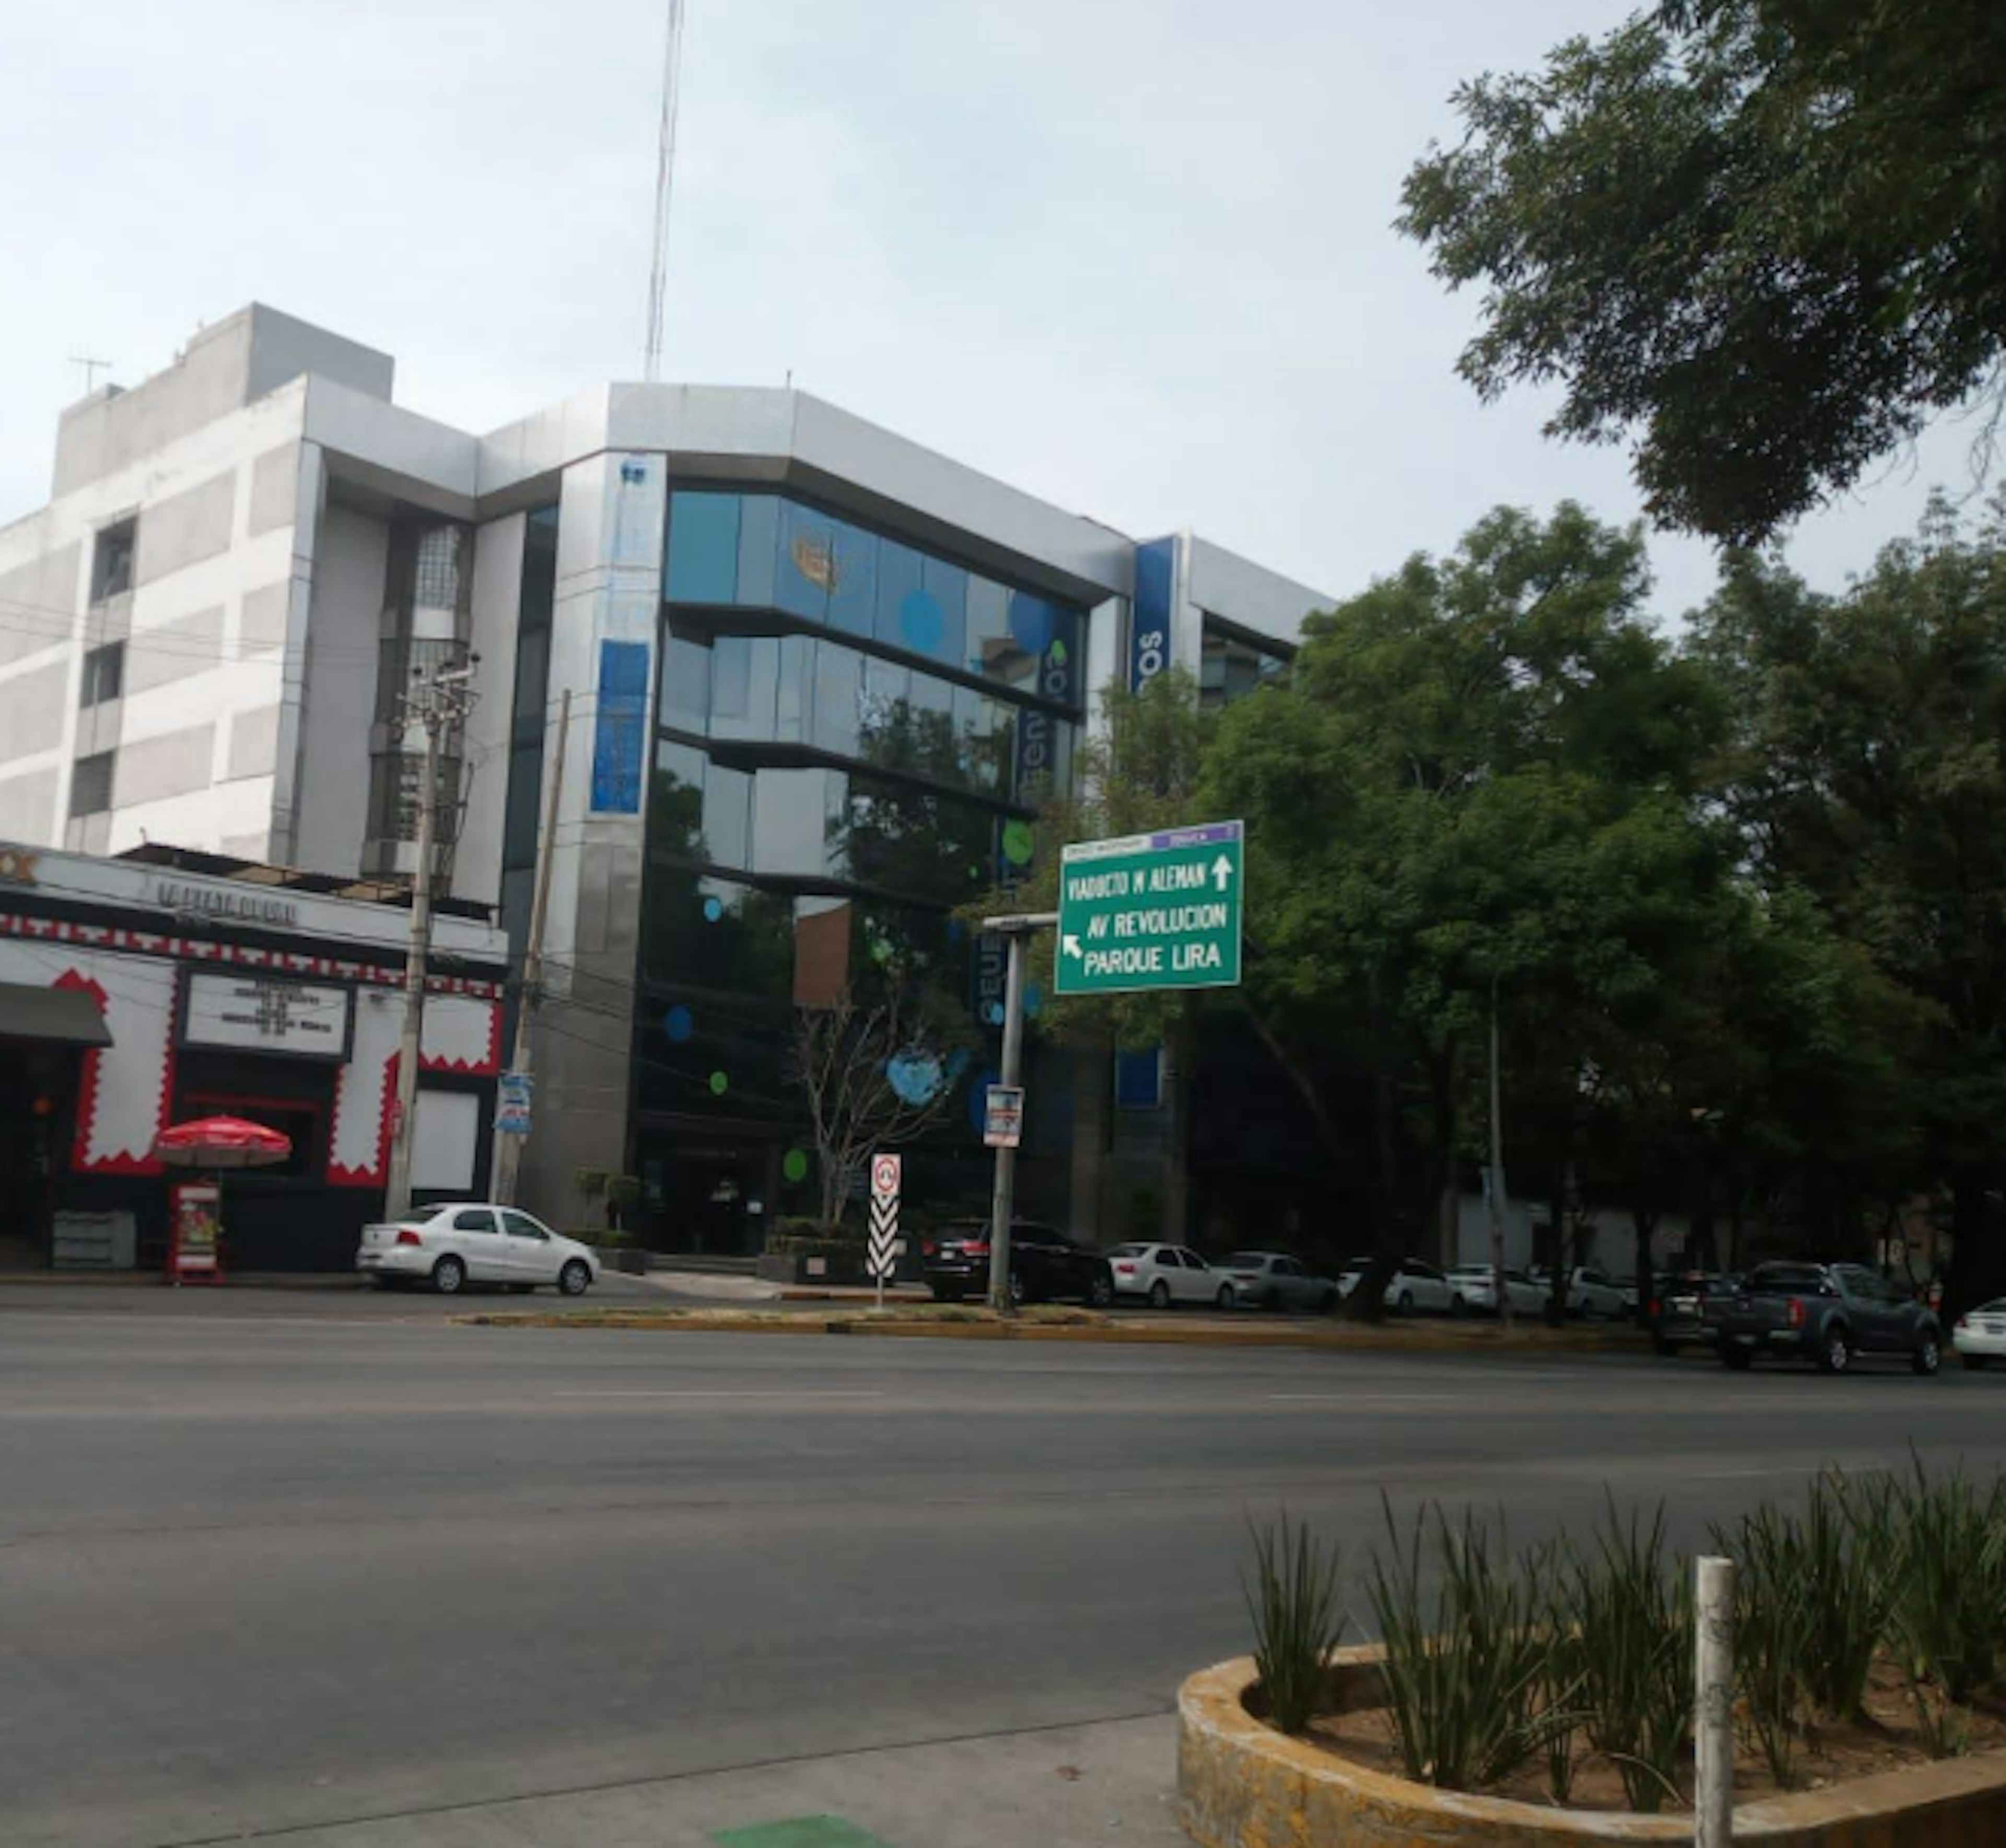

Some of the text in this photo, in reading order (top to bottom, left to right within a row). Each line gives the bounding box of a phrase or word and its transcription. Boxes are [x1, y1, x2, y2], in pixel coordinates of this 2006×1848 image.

[1149, 862, 1207, 892] ALEMAN
[1087, 902, 1227, 939] AV REVOLUCION
[1083, 942, 1222, 977] PARQUE LIRA
